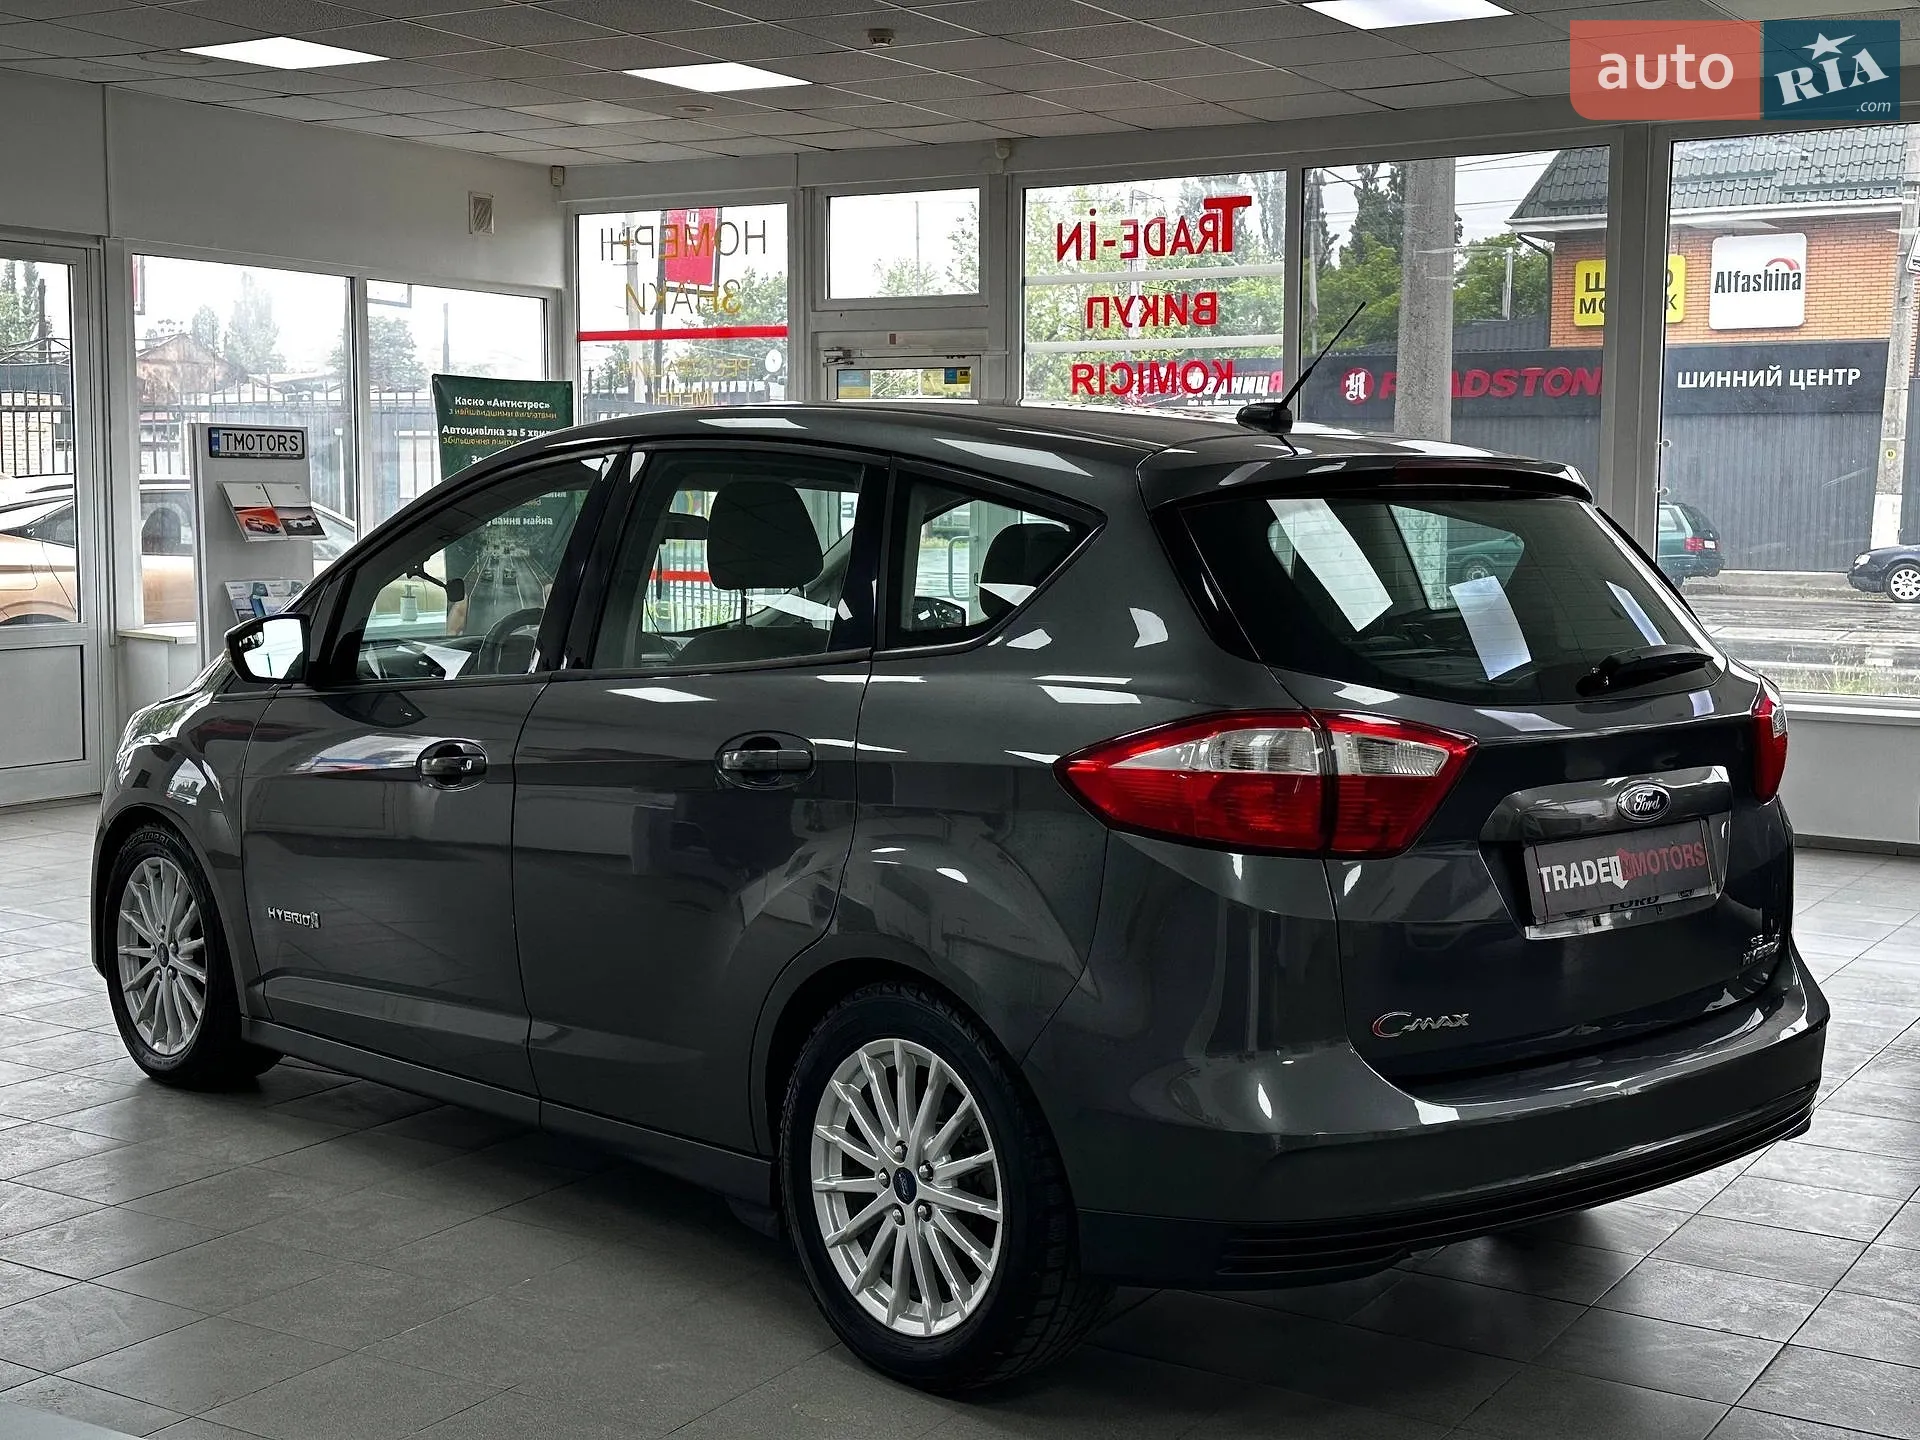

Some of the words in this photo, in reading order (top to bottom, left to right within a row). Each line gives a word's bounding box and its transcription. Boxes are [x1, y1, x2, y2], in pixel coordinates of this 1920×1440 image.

[1714, 268, 1801, 294] Alfashina
[1677, 365, 1782, 389] ШИННИЙ
[1789, 367, 1861, 390] ЦЕНТР
[454, 396, 484, 406] Каско
[486, 397, 550, 410] «Антистрес»
[442, 425, 505, 437] Автоцивілка
[507, 428, 518, 437] за
[519, 428, 526, 437] 5
[222, 433, 299, 452] TMOTORS
[522, 515, 553, 525] майна
[1633, 791, 1661, 812] Ford
